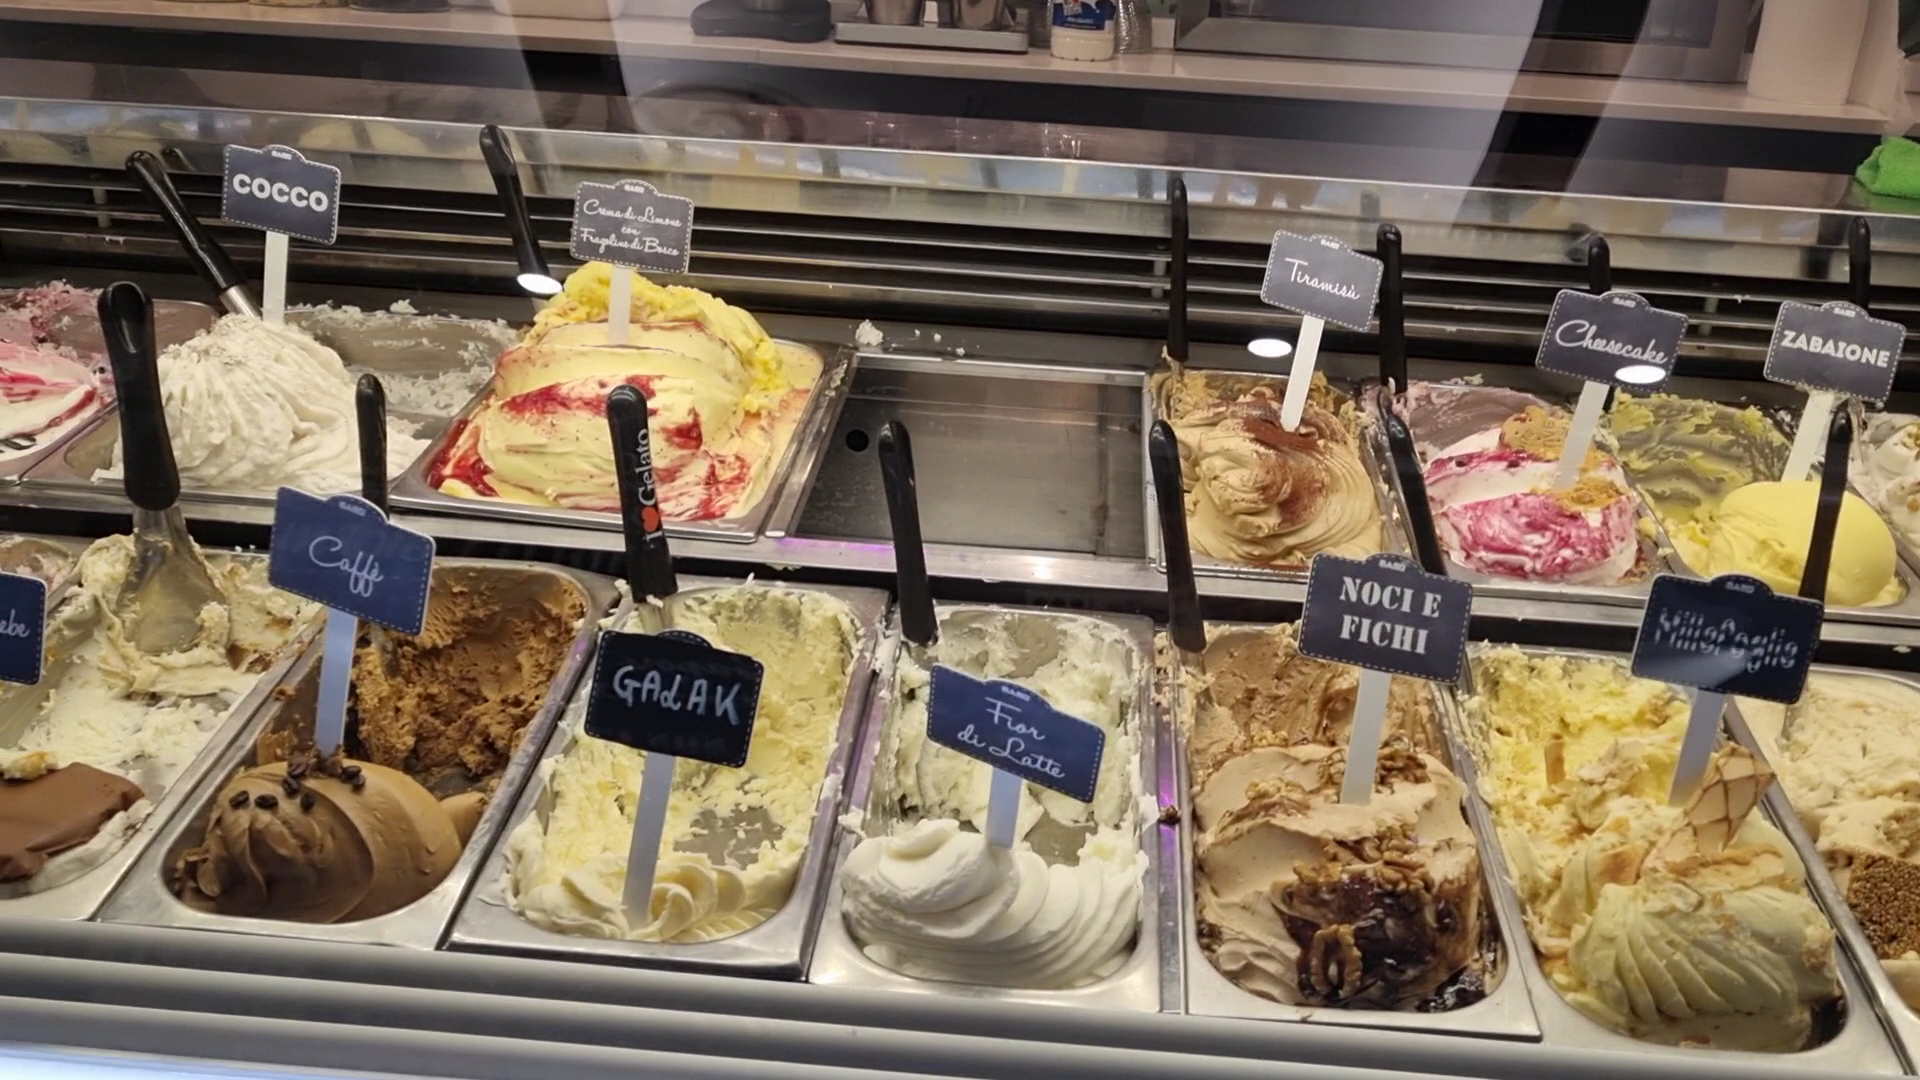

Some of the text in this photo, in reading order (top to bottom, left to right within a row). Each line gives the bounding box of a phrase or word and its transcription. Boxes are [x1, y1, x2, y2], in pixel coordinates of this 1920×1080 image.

[232, 173, 329, 212] COCCO
[583, 199, 682, 227] Crema di Limone
[621, 226, 641, 235] con
[629, 237, 644, 250] di
[642, 237, 680, 256] Bosco
[1284, 257, 1360, 300] Tiramisù
[1555, 319, 1668, 365] Cheesecake
[1780, 330, 1891, 368] ZABAIONE
[635, 428, 657, 506] Gelato
[308, 535, 384, 598] Caffè
[1339, 576, 1442, 618] NOCI E
[1339, 614, 1429, 654] FICHI
[984, 696, 1046, 741] Fior
[957, 723, 1066, 778] di Latte
